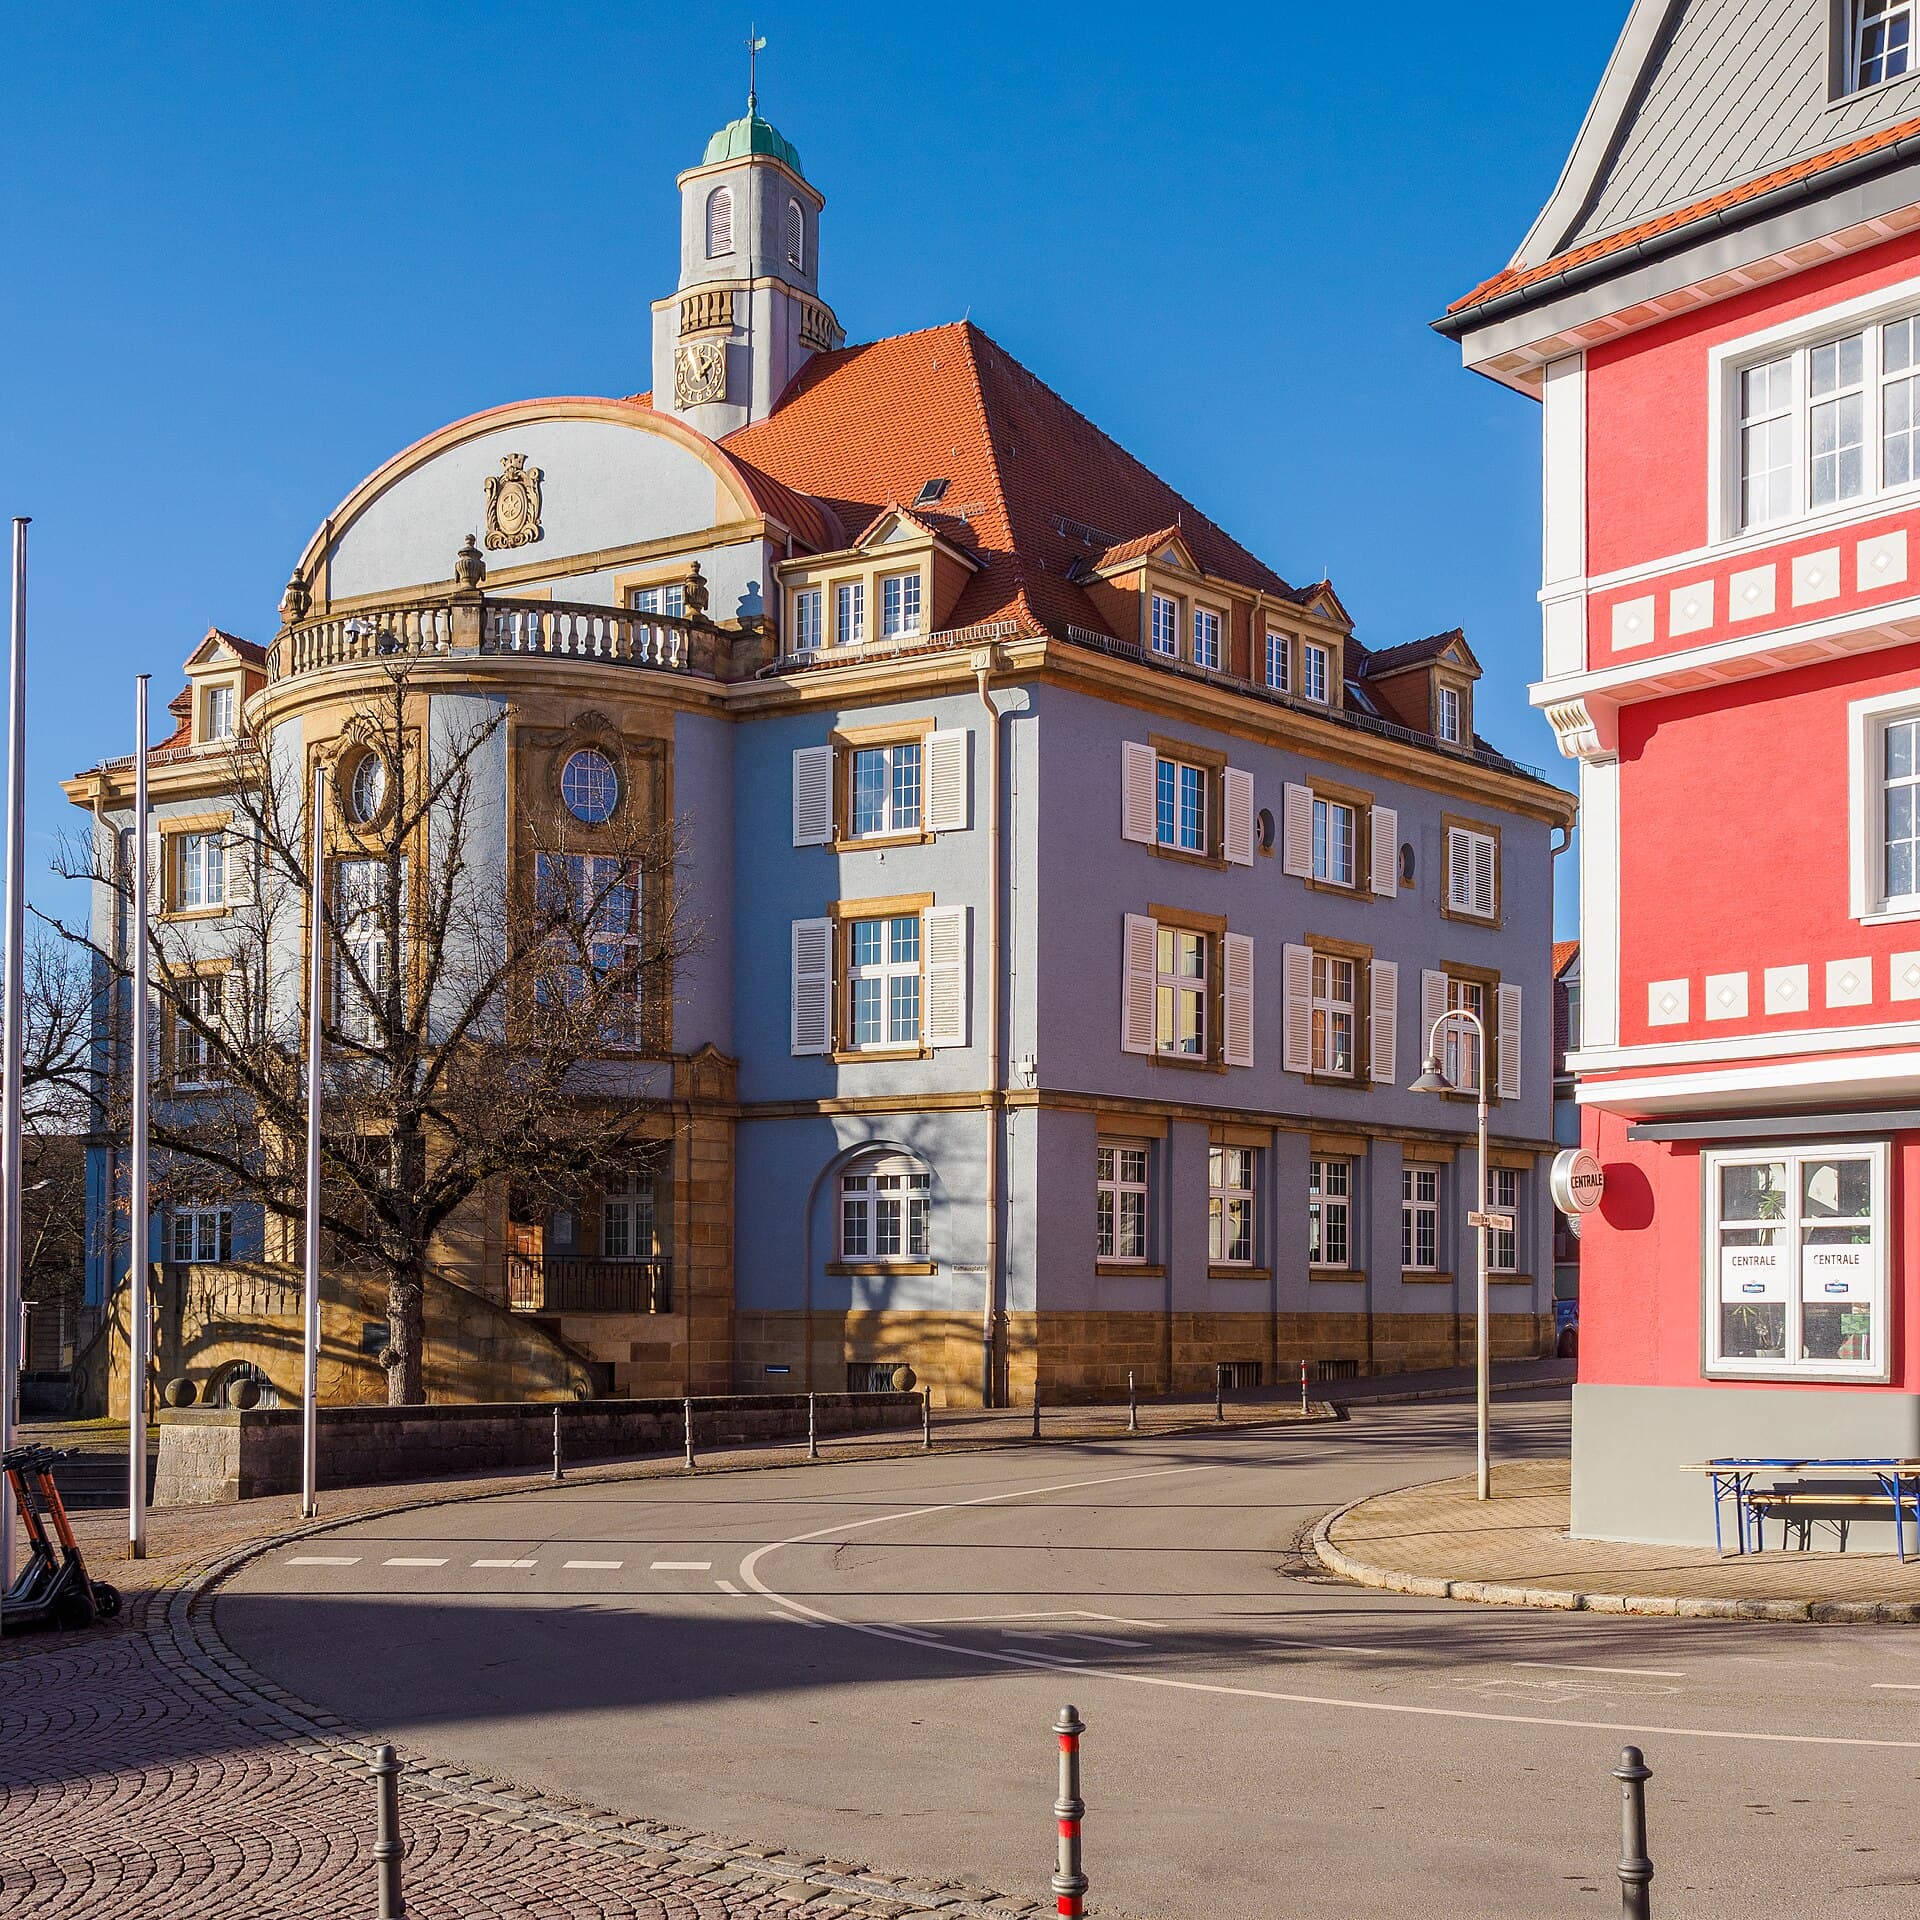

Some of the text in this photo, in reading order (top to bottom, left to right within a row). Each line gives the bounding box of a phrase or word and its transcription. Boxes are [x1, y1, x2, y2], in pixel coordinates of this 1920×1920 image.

[678, 373, 683, 383] 9
[712, 377, 718, 386] 4
[681, 383, 686, 394] 8
[706, 386, 712, 396] 5
[688, 391, 693, 400] 7
[697, 392, 703, 401] 6
[1571, 1173, 1603, 1189] CENTRALE
[1732, 1256, 1776, 1266] CENTRALE
[1813, 1254, 1860, 1265] CENTRALE
